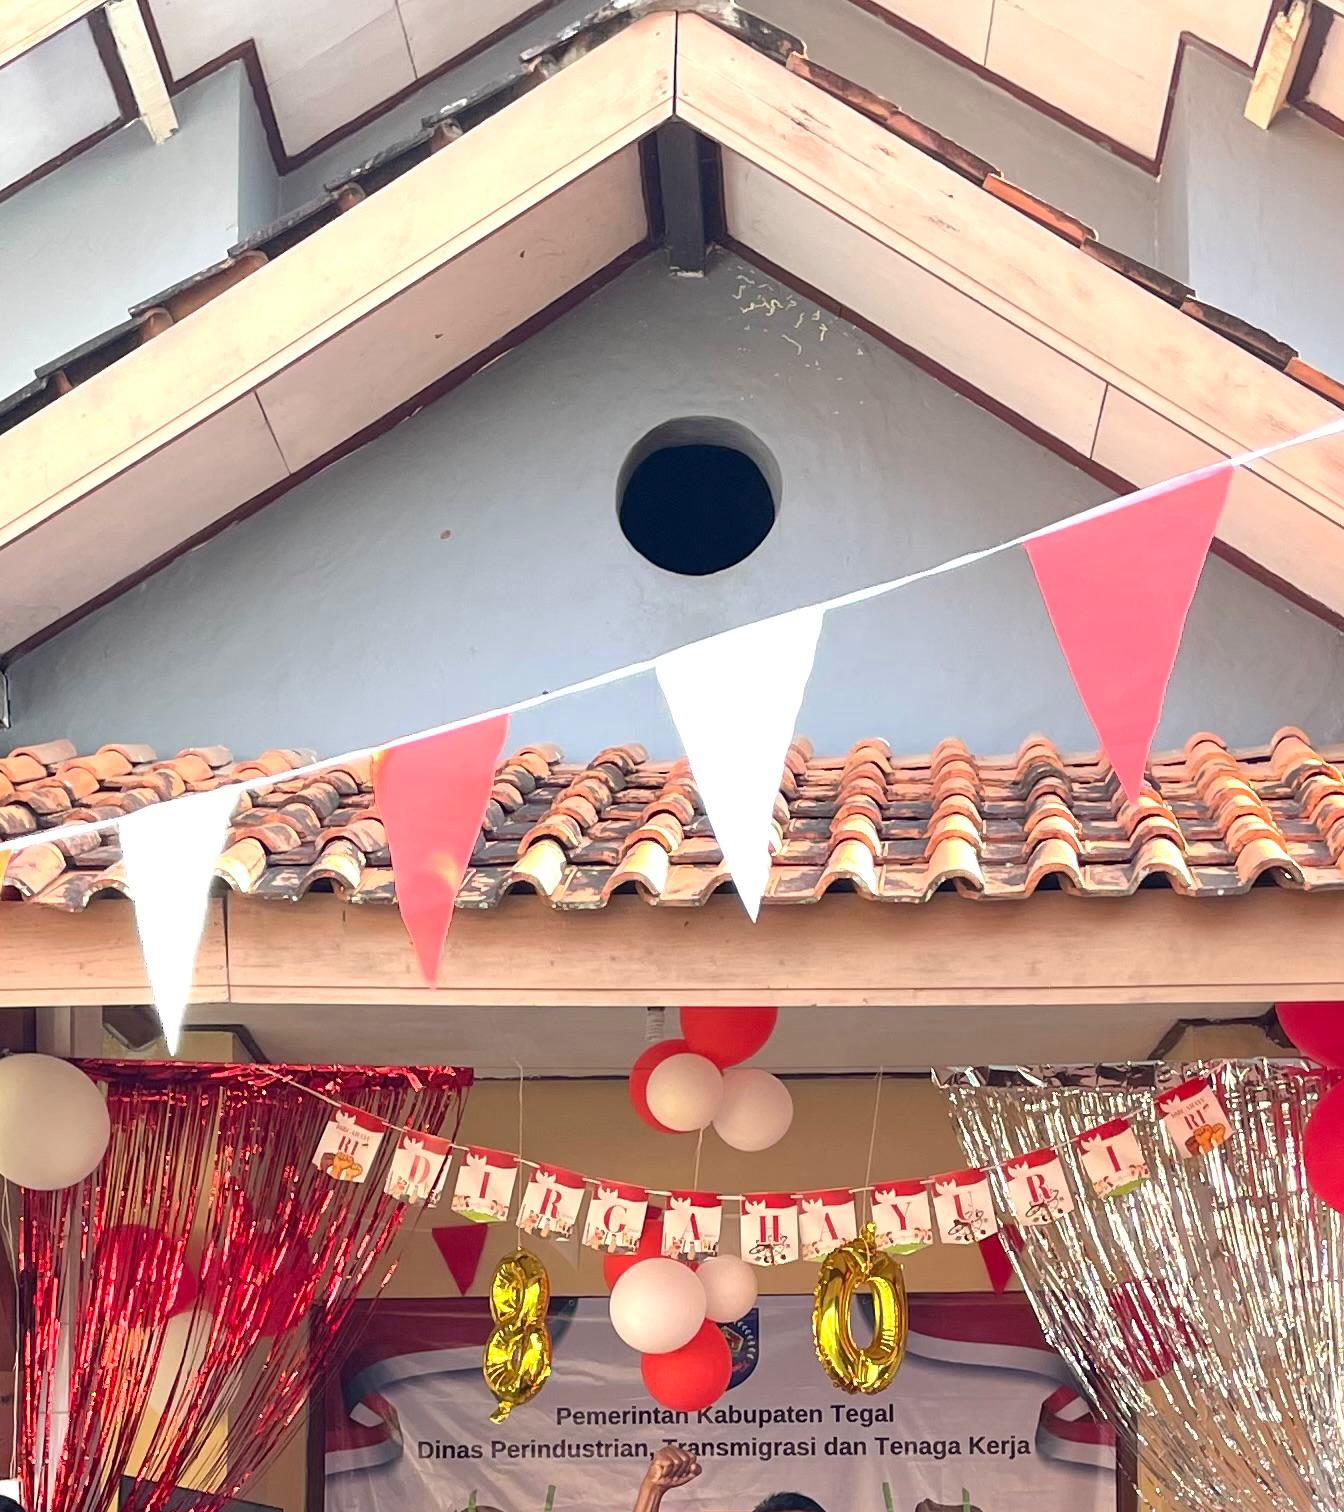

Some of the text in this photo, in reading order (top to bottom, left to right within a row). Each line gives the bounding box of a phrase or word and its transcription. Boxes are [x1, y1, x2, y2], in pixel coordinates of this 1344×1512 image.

[697, 1404, 823, 1428] Kabupaten
[830, 1403, 895, 1427] Tegal
[417, 1440, 483, 1459] Dinas
[491, 1438, 655, 1461] Perindustrian,
[824, 1436, 867, 1456] dan
[875, 1436, 962, 1461] Tenaga
[968, 1435, 1032, 1461] Kerja
